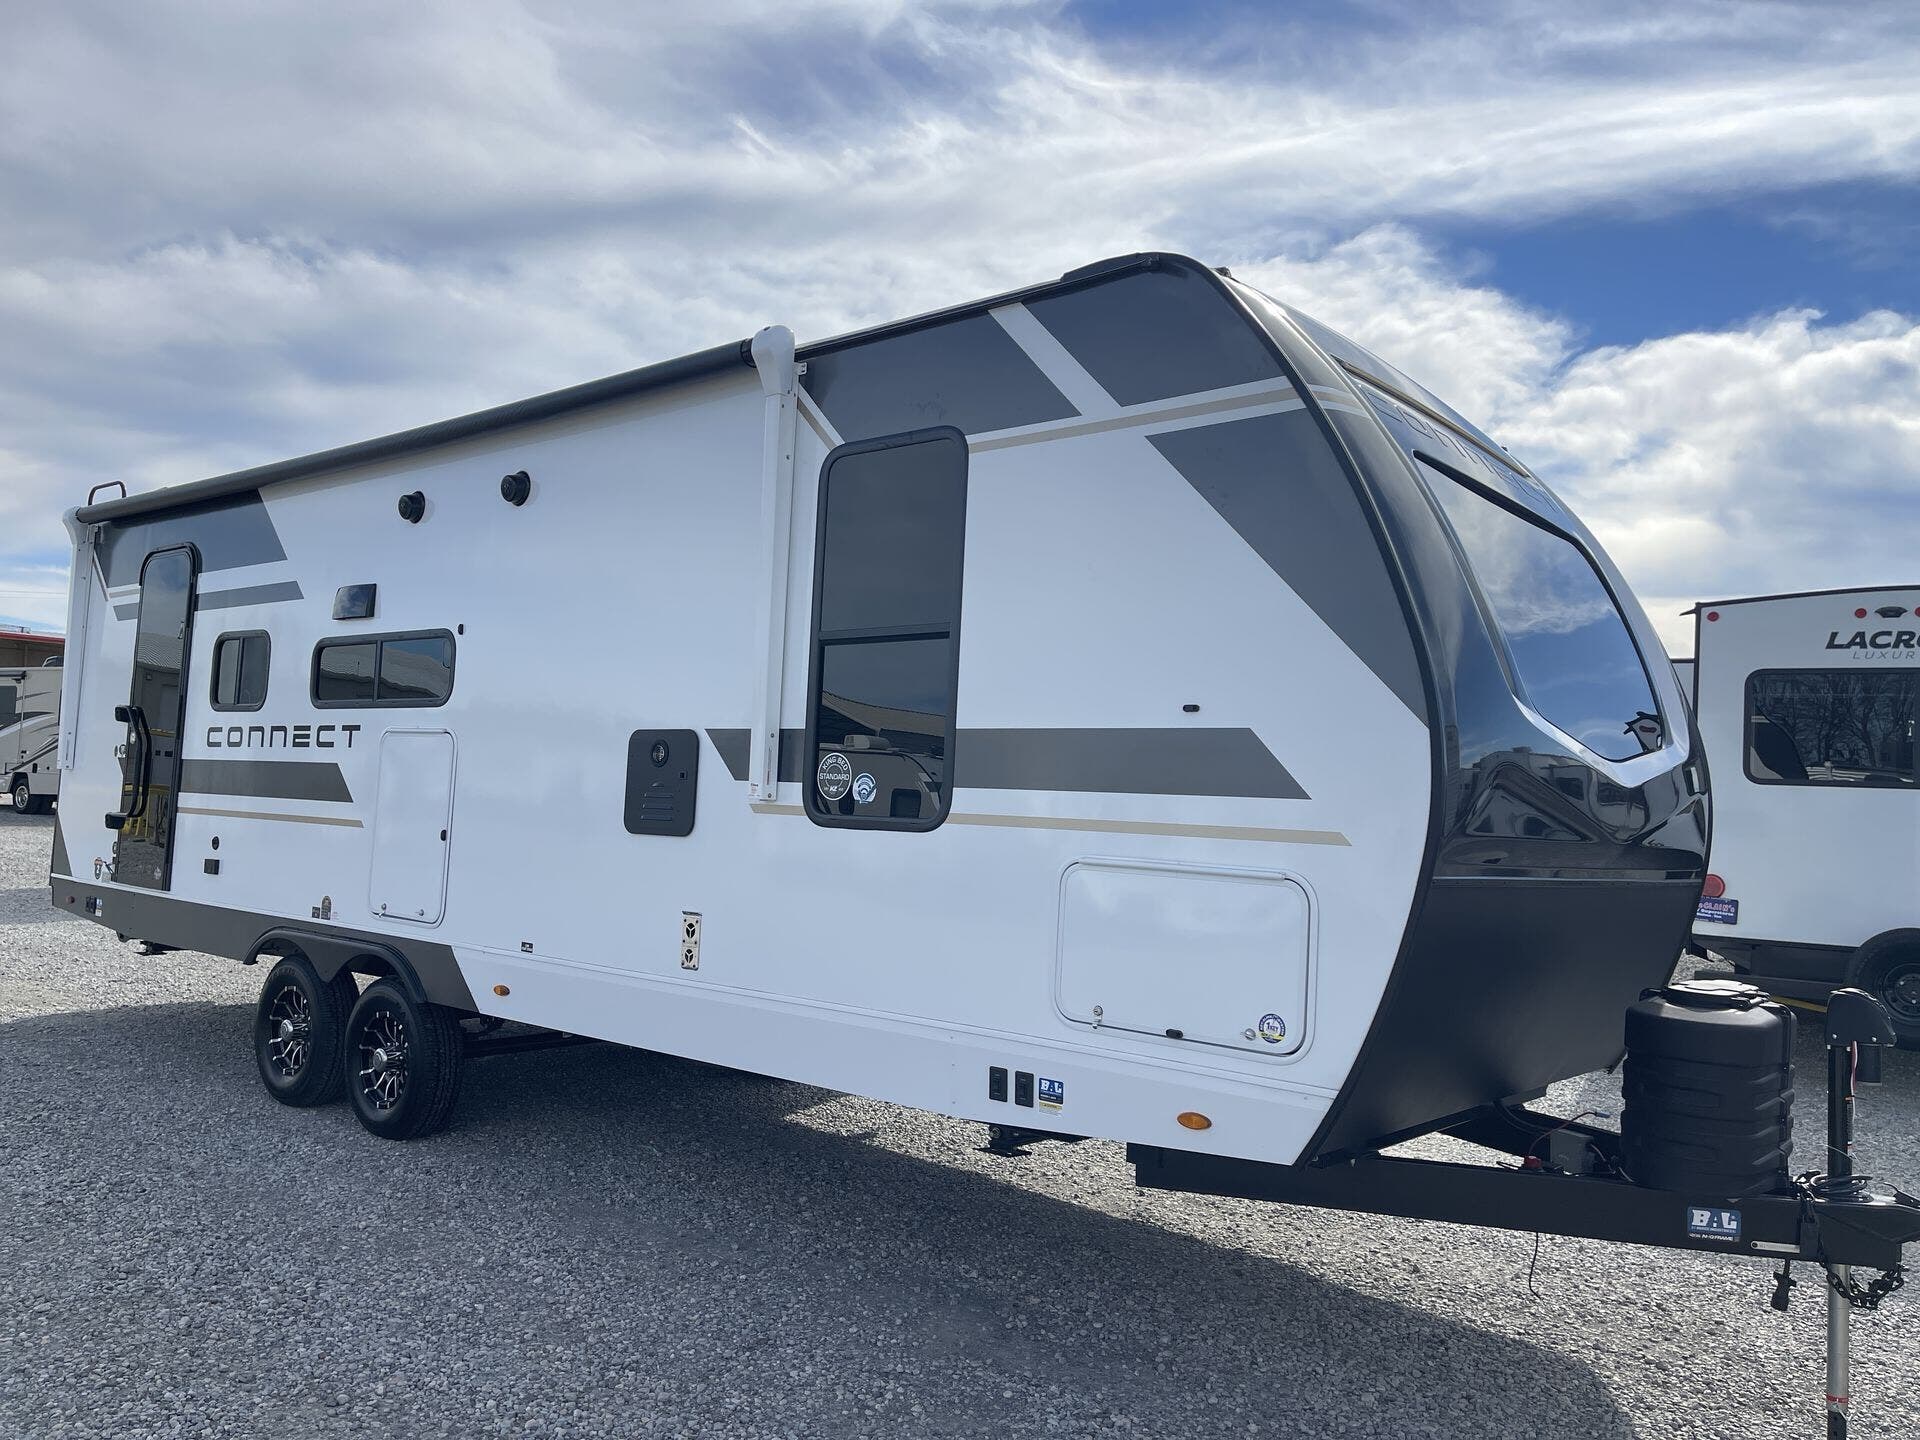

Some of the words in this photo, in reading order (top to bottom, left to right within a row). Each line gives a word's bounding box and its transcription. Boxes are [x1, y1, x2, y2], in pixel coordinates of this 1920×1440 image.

[1825, 630, 1920, 650] LACR
[1852, 650, 1919, 660] LUXUR
[206, 724, 362, 749] CONNECT
[822, 756, 837, 770] KING
[837, 757, 848, 771] BED
[819, 772, 850, 781] STANDARD
[1691, 1209, 1738, 1230] BAL
